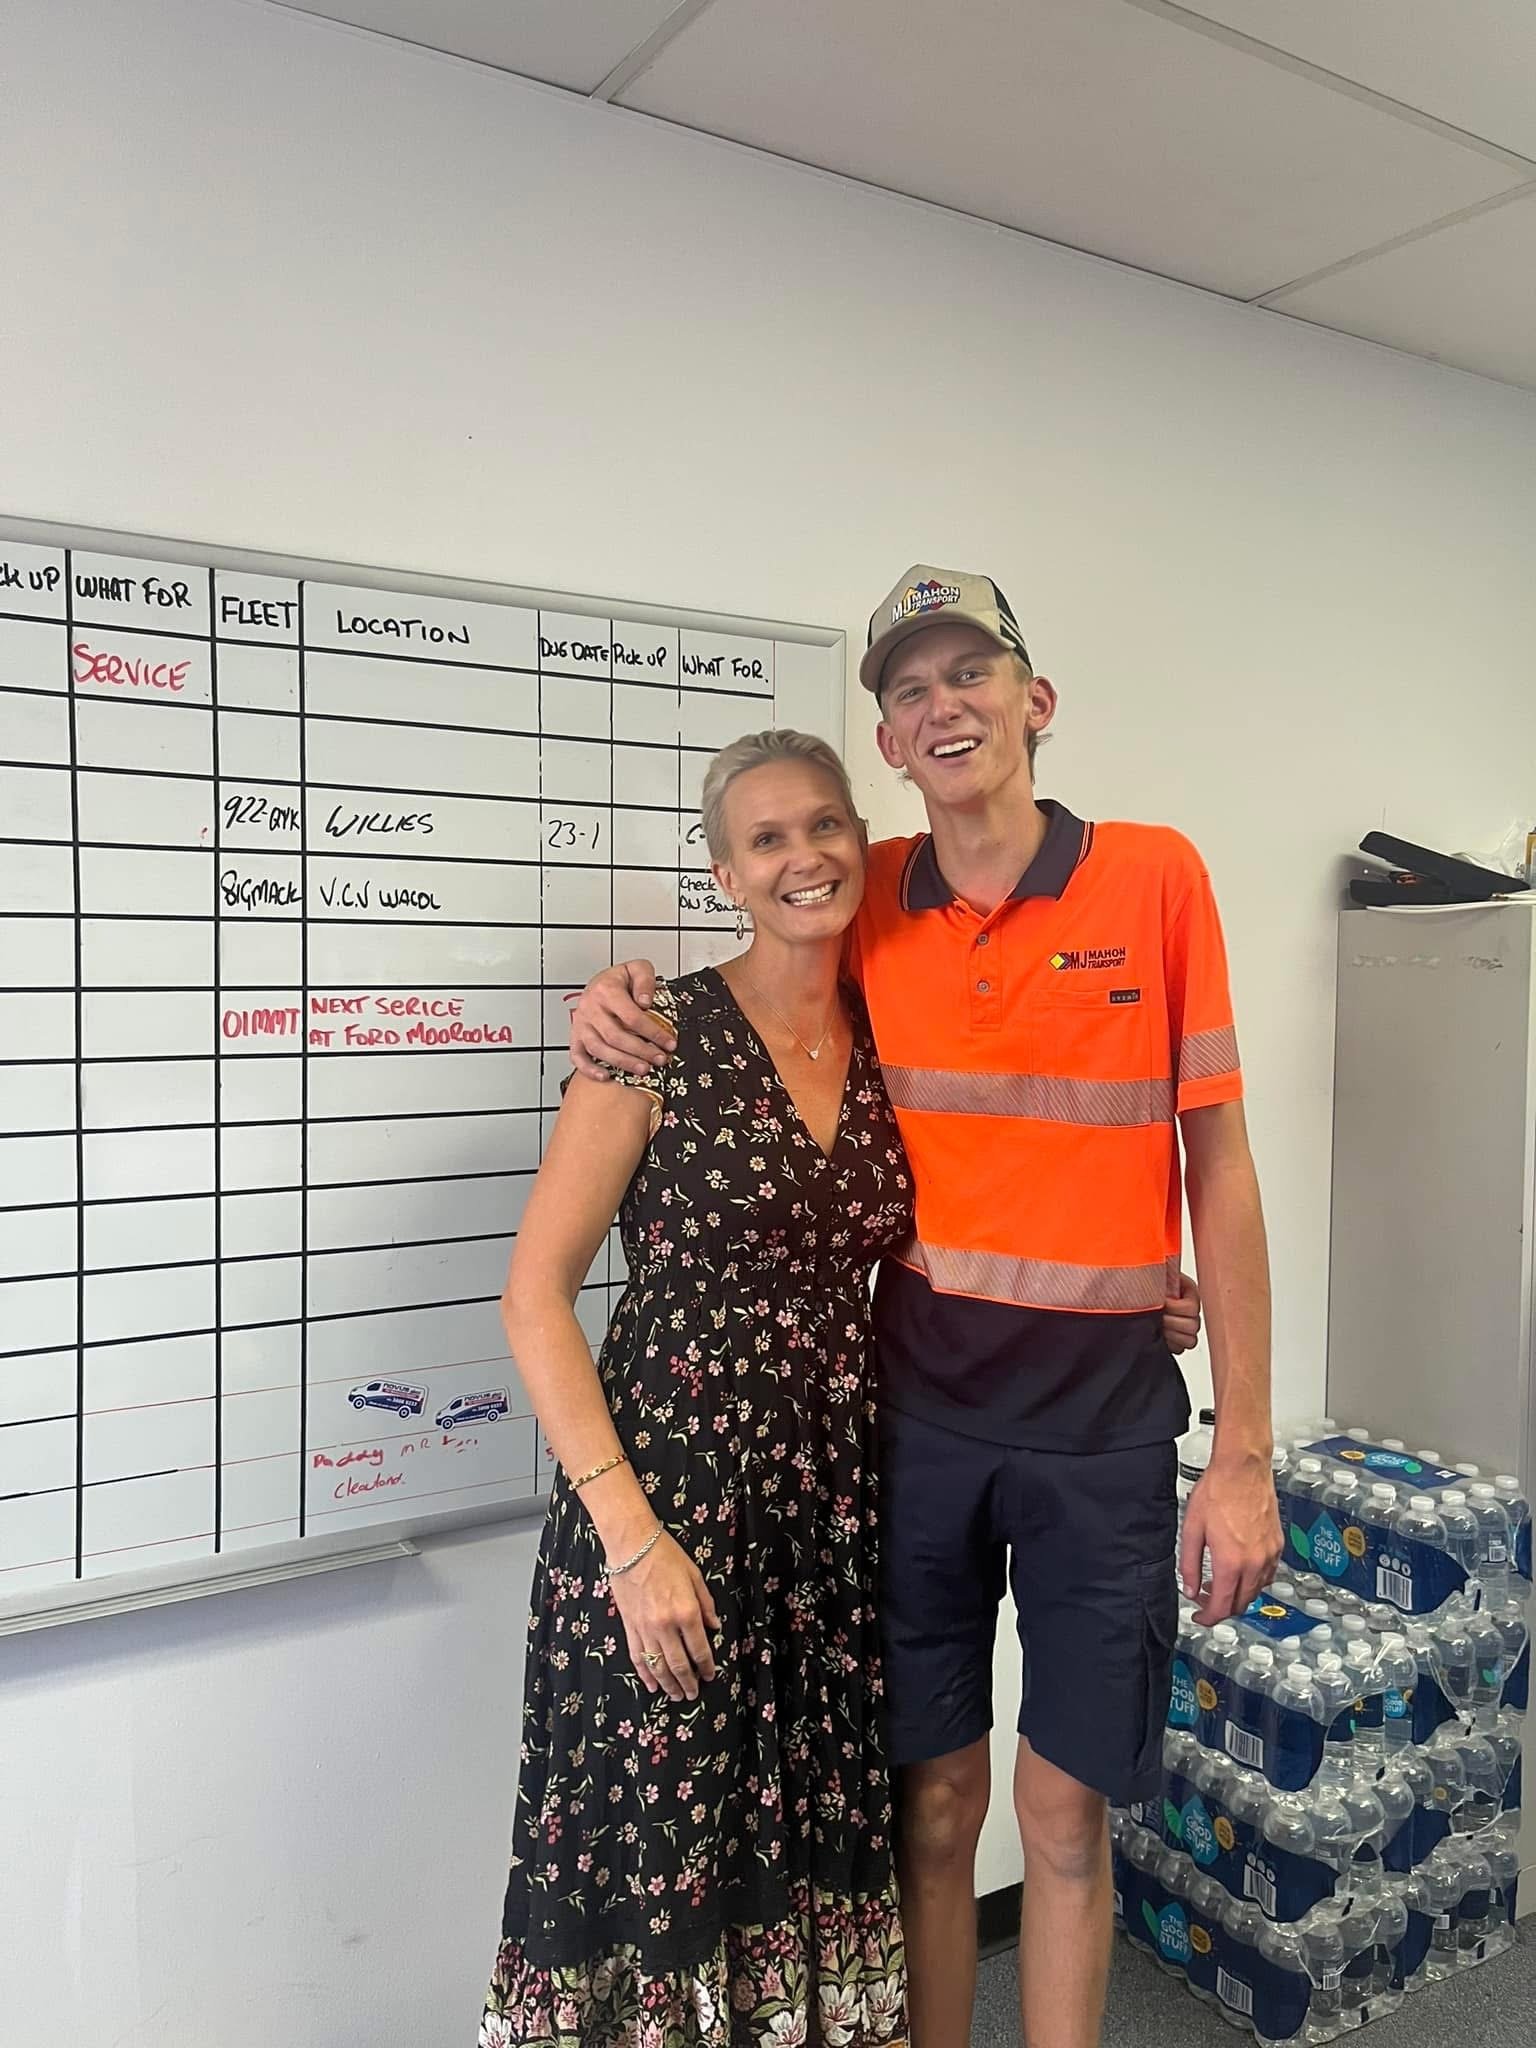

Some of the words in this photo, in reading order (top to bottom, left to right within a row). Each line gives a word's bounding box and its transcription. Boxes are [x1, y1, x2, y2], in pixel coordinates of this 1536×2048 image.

[29, 566, 61, 592] UP
[76, 575, 136, 602] WHAT
[142, 577, 192, 608] FOR
[912, 586, 959, 603] MAHON
[221, 596, 298, 629] FLEET
[911, 595, 958, 611] TRANSPORT
[336, 609, 470, 645] LOCATION
[570, 642, 609, 662] DATE
[73, 643, 192, 691] SERVICE
[324, 805, 434, 837] WILLIES
[548, 819, 600, 850] 23-1
[680, 875, 718, 892] Check
[378, 888, 442, 911] WACOL
[680, 895, 701, 911] ON
[1087, 957, 1126, 970] TRANSPORT
[1088, 946, 1126, 961] MAHON
[311, 996, 371, 1015] NEXT
[309, 1028, 336, 1047] AT
[344, 1023, 400, 1046] FORD
[1319, 1525, 1334, 1541] THE
[1313, 1534, 1341, 1555] GOOD
[1313, 1545, 1342, 1568] STUFF
[1172, 1674, 1189, 1689] THE
[1171, 1686, 1195, 1702] OOD
[1170, 1696, 1196, 1717] TUFF
